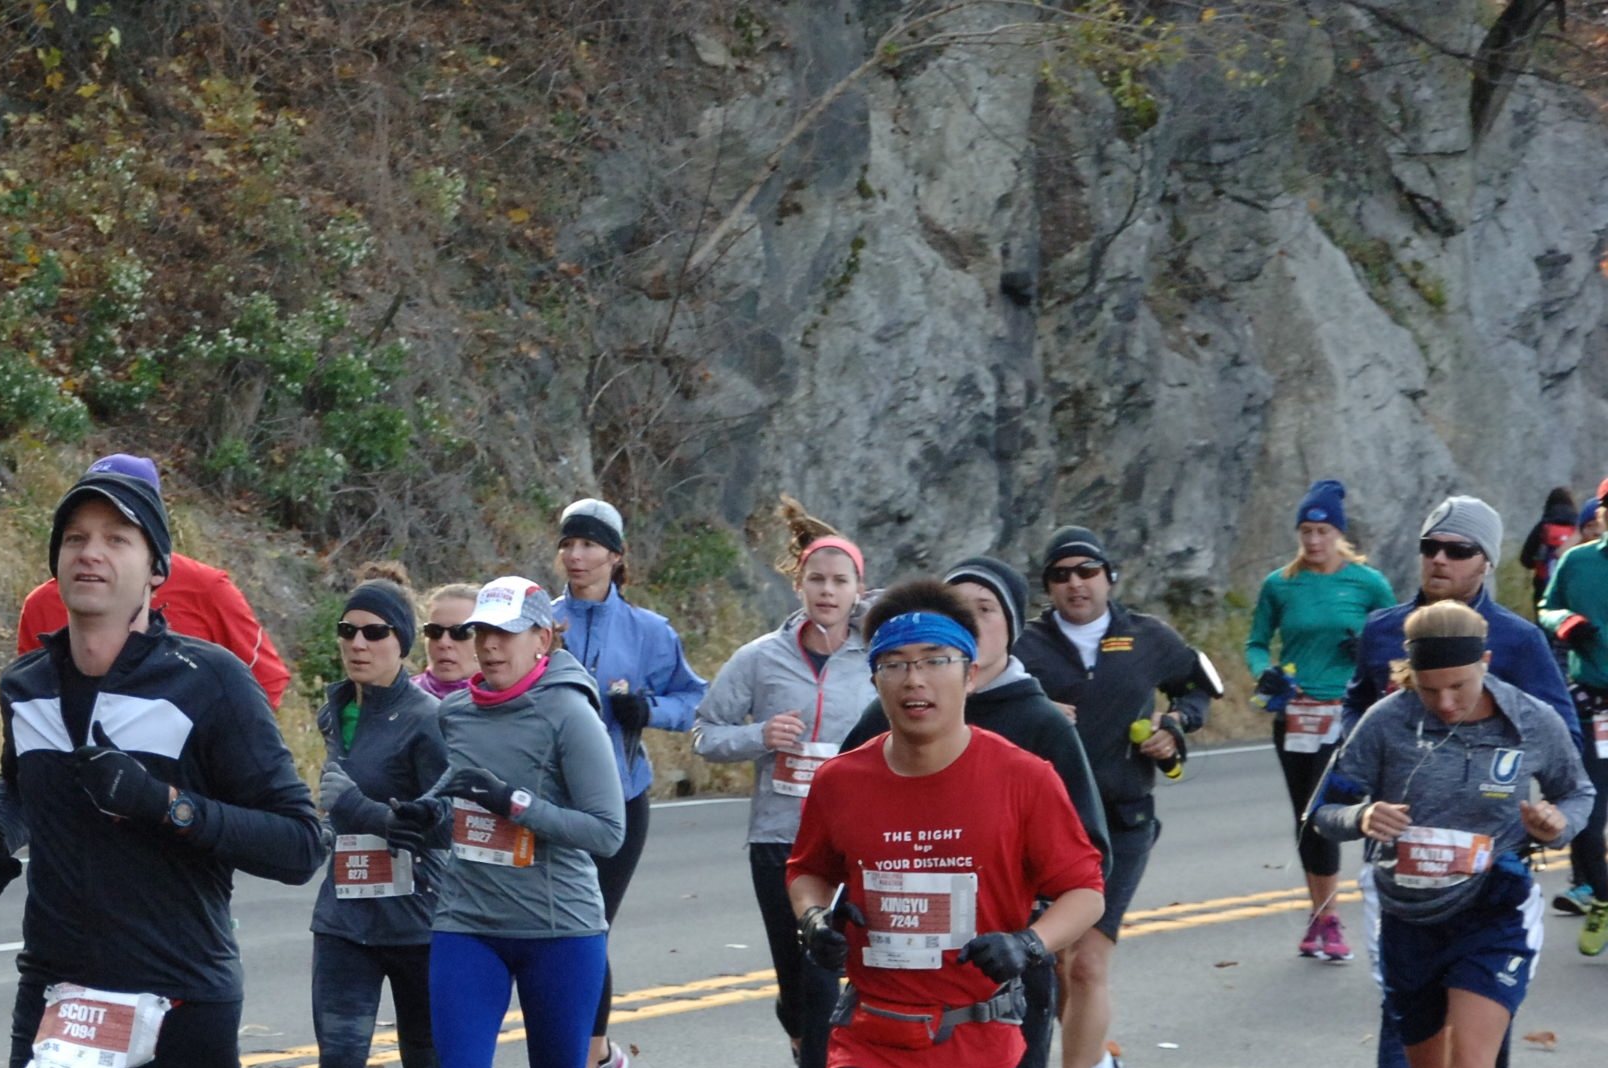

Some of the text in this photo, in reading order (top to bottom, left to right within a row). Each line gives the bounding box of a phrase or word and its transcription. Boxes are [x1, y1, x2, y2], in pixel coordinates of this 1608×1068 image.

[465, 815, 497, 832] PAIGE
[883, 829, 963, 842] THE RIGHT
[913, 844, 933, 853] to go
[345, 855, 369, 868] JULIE
[875, 857, 973, 871] YOUR DISTANCE
[880, 897, 929, 914] XINGYU
[890, 914, 920, 928] 7244
[58, 1003, 108, 1025] SCOTT
[63, 1021, 97, 1040] 7094
